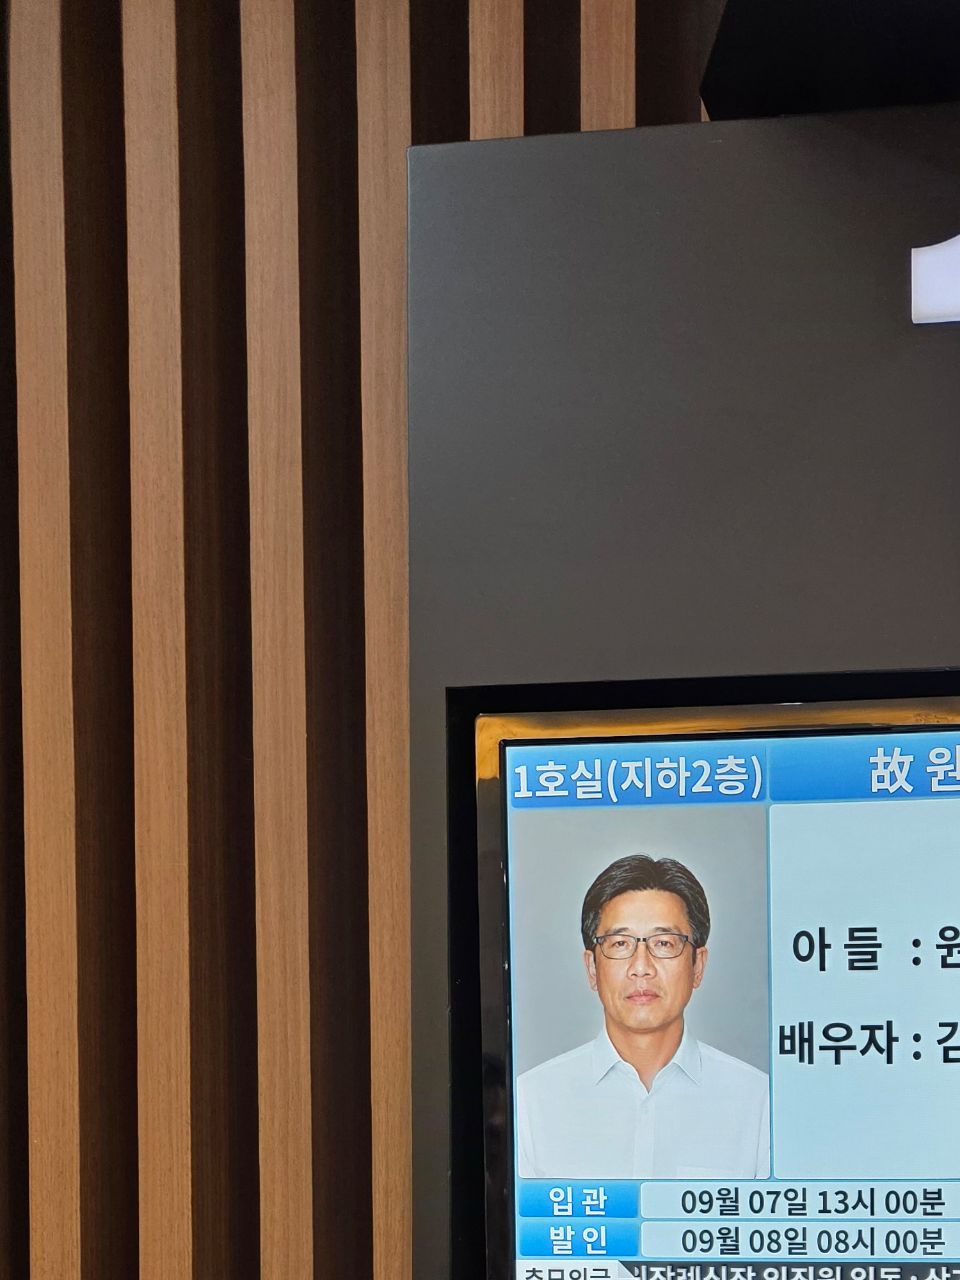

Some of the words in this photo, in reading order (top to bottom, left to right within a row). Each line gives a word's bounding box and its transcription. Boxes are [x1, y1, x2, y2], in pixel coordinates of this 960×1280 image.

[513, 755, 763, 803] 1호실(지하2층)
[869, 747, 914, 793] 故
[778, 1020, 899, 1065] 배우자
[680, 1188, 741, 1216] 09월
[749, 1187, 808, 1217] 07일
[817, 1187, 877, 1216] 13시
[884, 1187, 946, 1216] 00분
[680, 1227, 741, 1256] 09월
[749, 1226, 808, 1256] 08일
[817, 1226, 877, 1256] 08시
[884, 1226, 946, 1256] 00분
